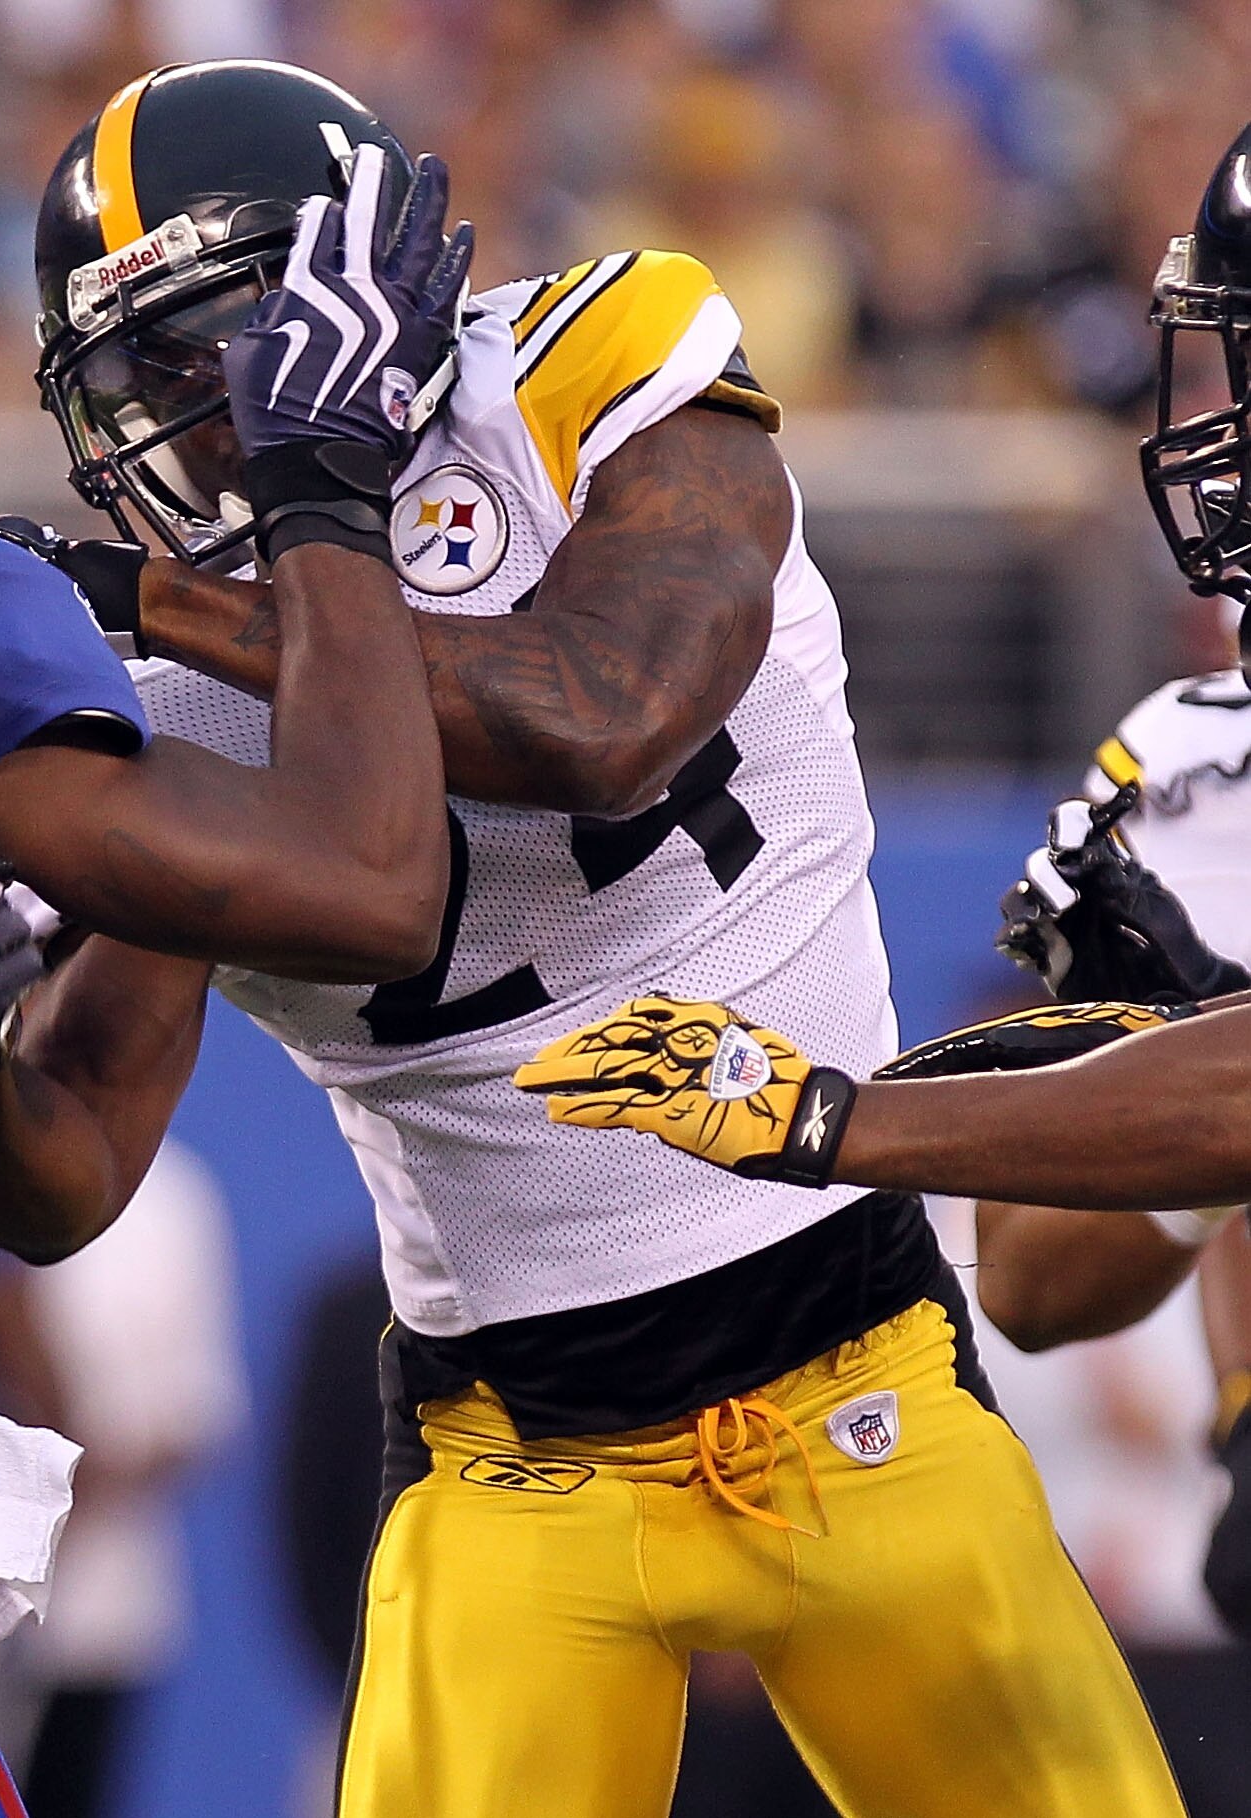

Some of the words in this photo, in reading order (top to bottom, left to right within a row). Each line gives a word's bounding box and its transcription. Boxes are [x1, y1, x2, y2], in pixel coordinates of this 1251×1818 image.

[401, 531, 443, 566] Steelers
[712, 1027, 739, 1094] EQUIPMENT
[740, 1054, 765, 1085] NFL
[856, 1426, 889, 1452] NFL
